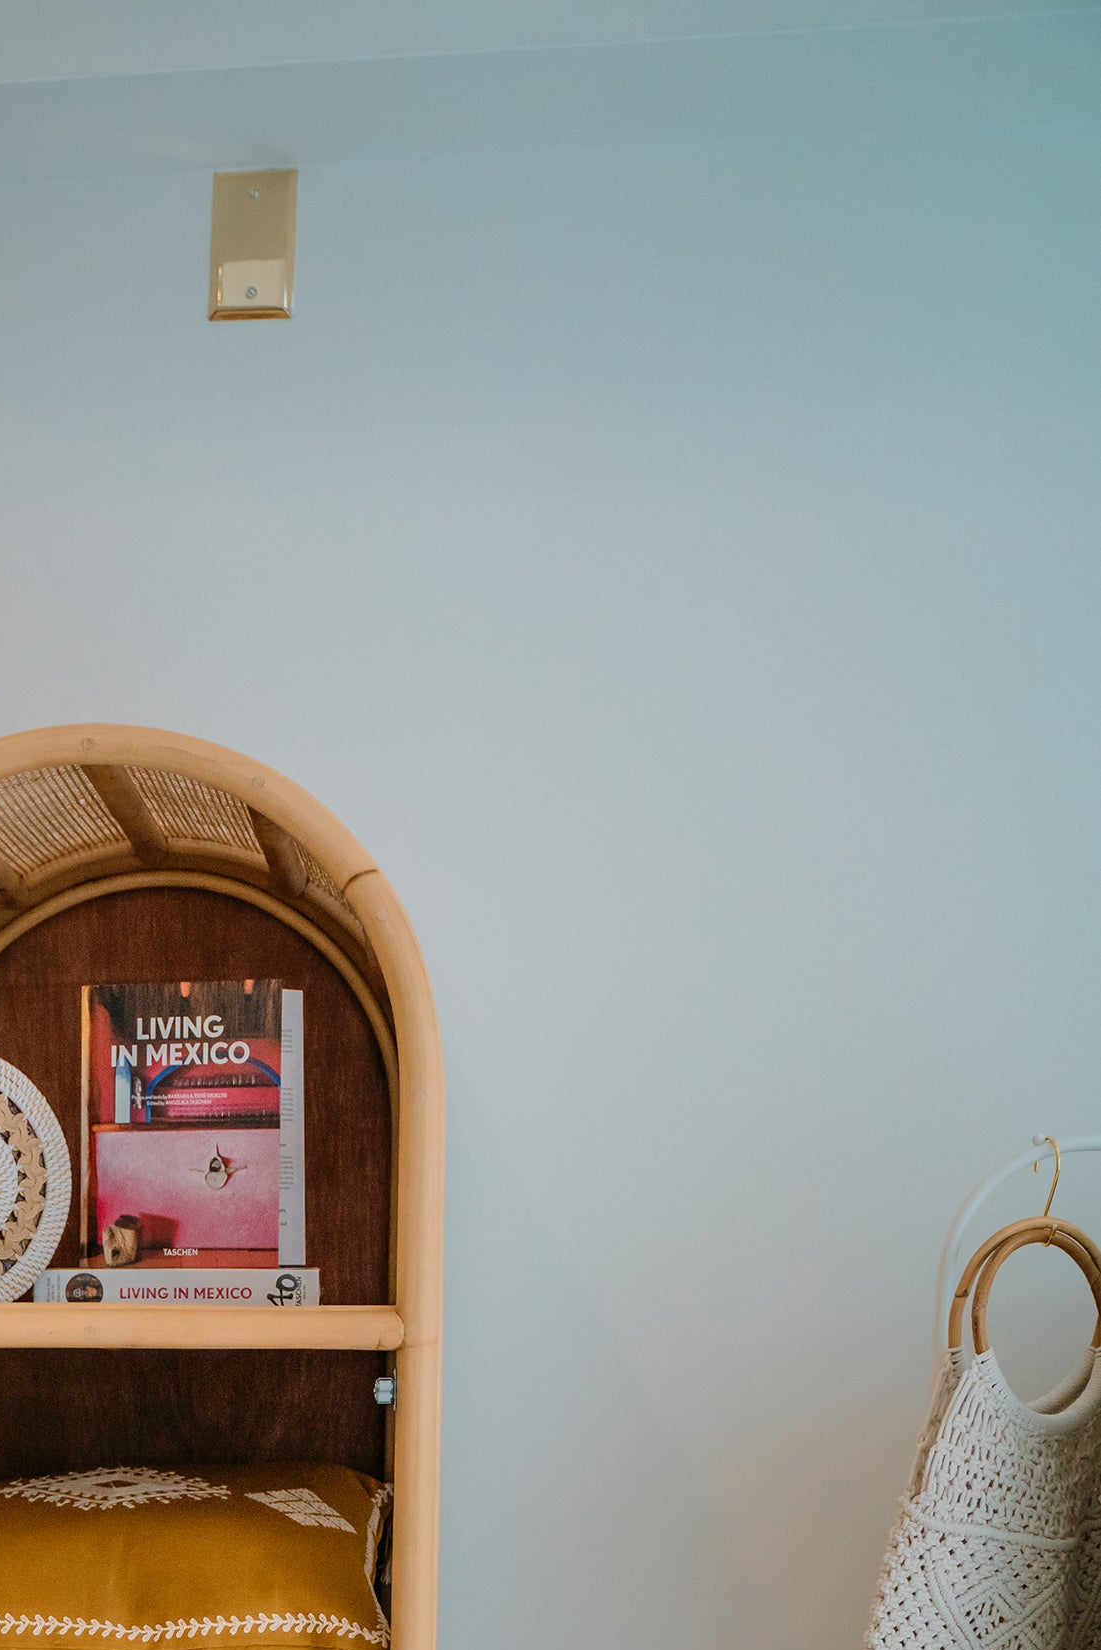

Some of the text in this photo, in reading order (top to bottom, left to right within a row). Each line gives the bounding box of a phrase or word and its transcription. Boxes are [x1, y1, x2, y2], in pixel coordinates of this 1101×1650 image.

[136, 1015, 225, 1040] LIVING
[111, 1041, 250, 1068] IN MEXICO
[163, 1248, 199, 1256] TASCHEN
[119, 1287, 253, 1300] LIVING IN MEXICO
